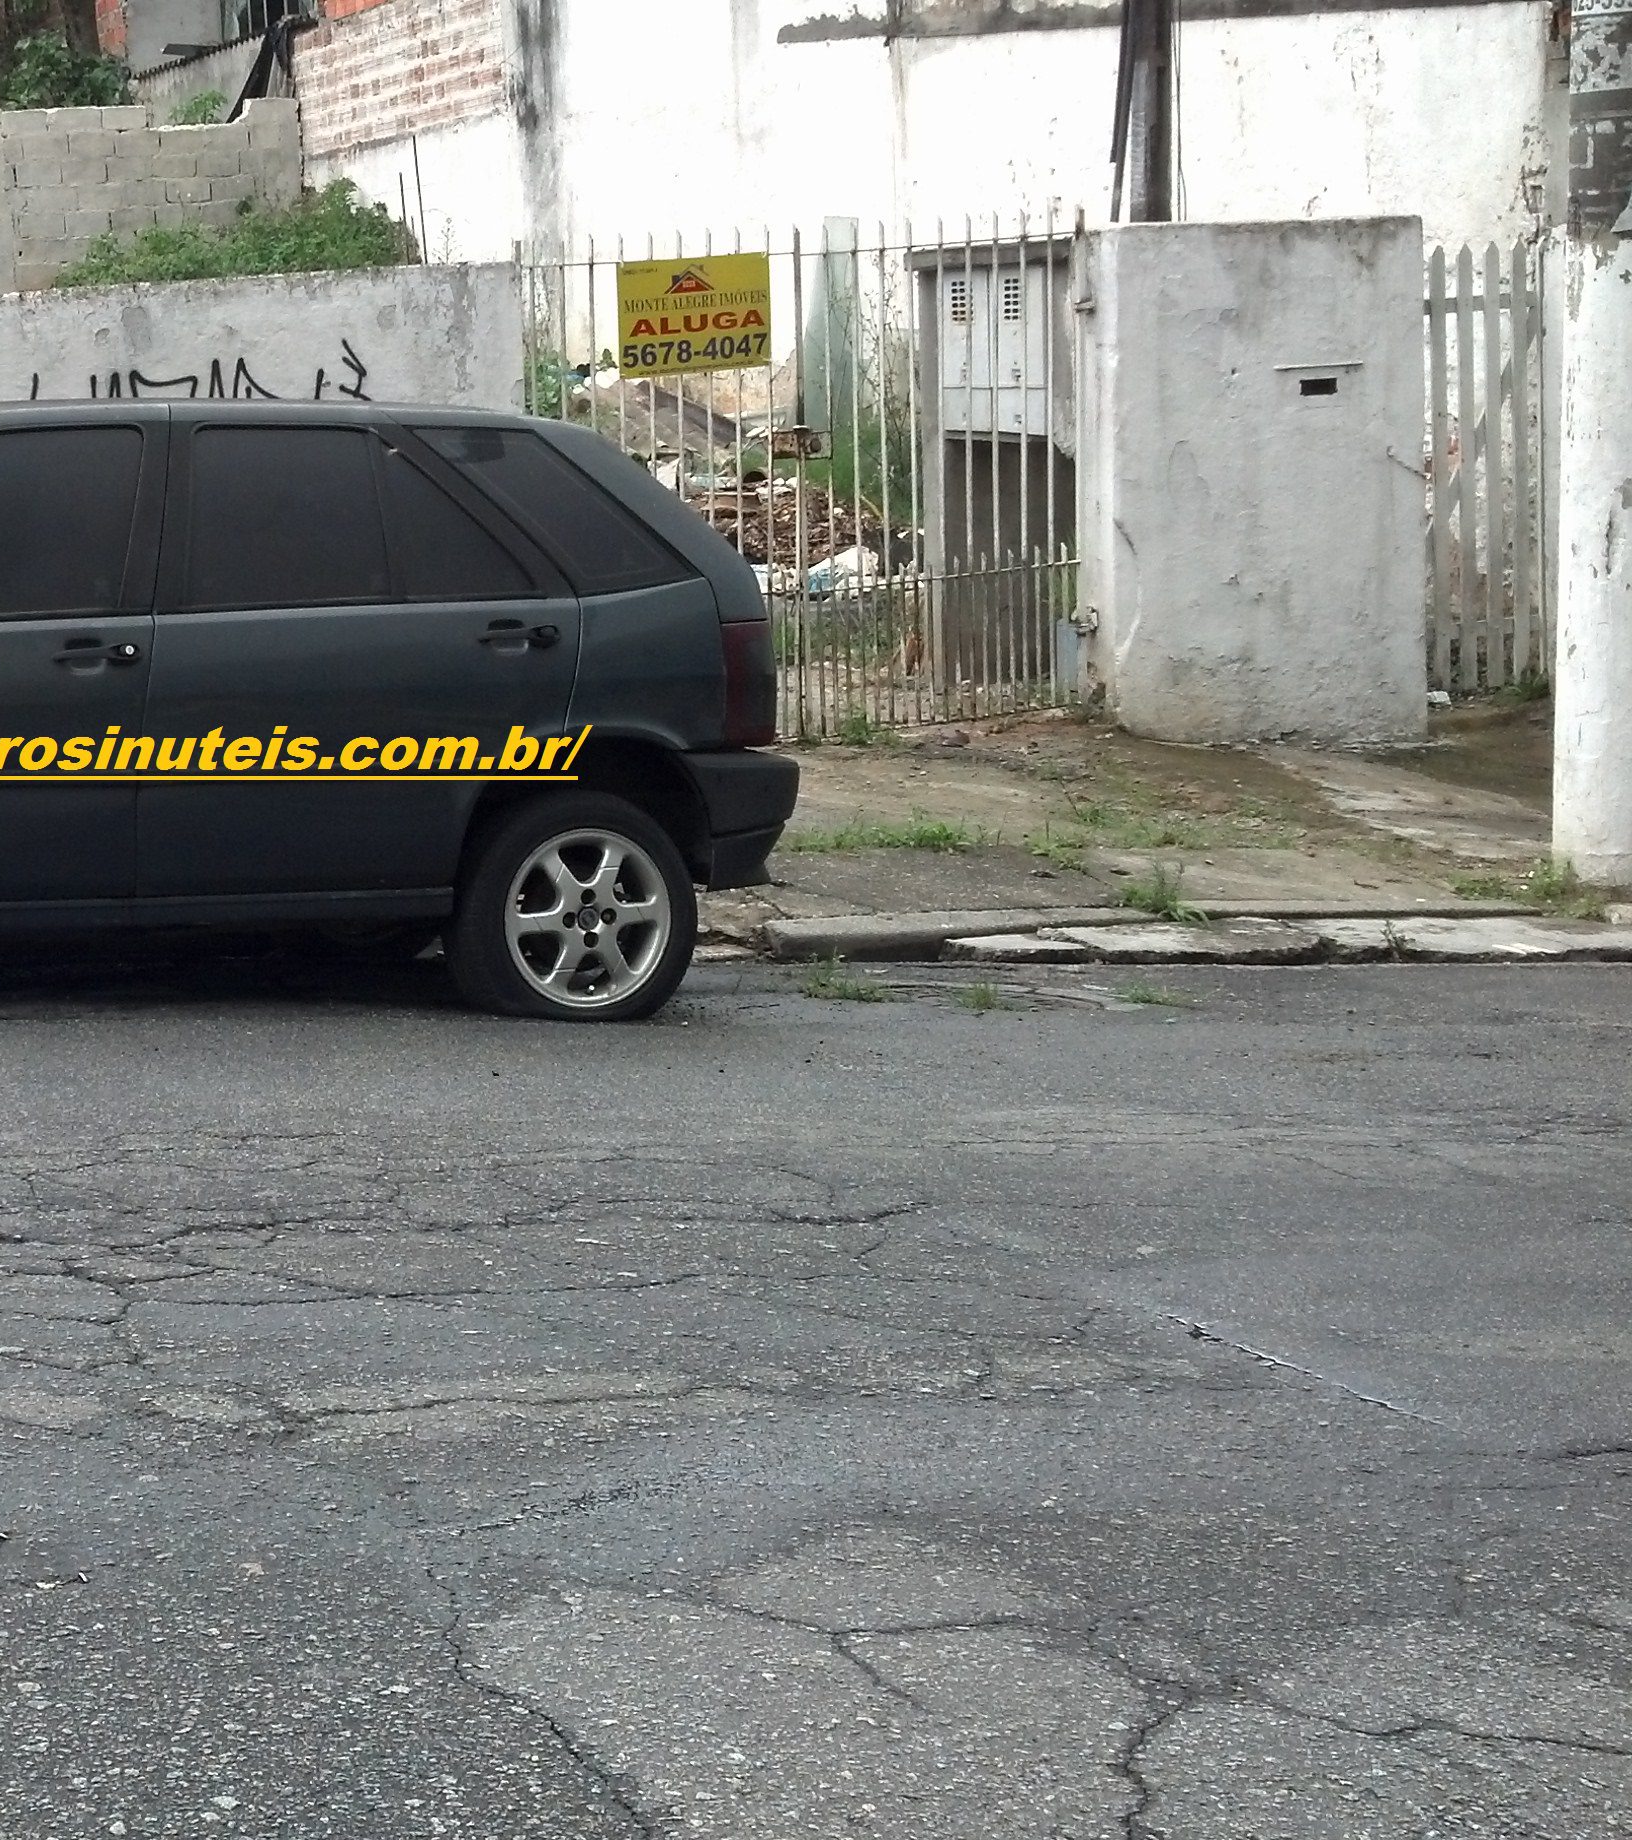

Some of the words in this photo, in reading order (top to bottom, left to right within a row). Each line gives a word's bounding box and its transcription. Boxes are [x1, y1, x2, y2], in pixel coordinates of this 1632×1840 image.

[624, 297, 669, 314] MONTE
[673, 293, 717, 310] ALEGRE
[719, 288, 768, 307] IMÓVEIS
[629, 309, 765, 338] ALUGA
[623, 332, 768, 369] 5678-4047
